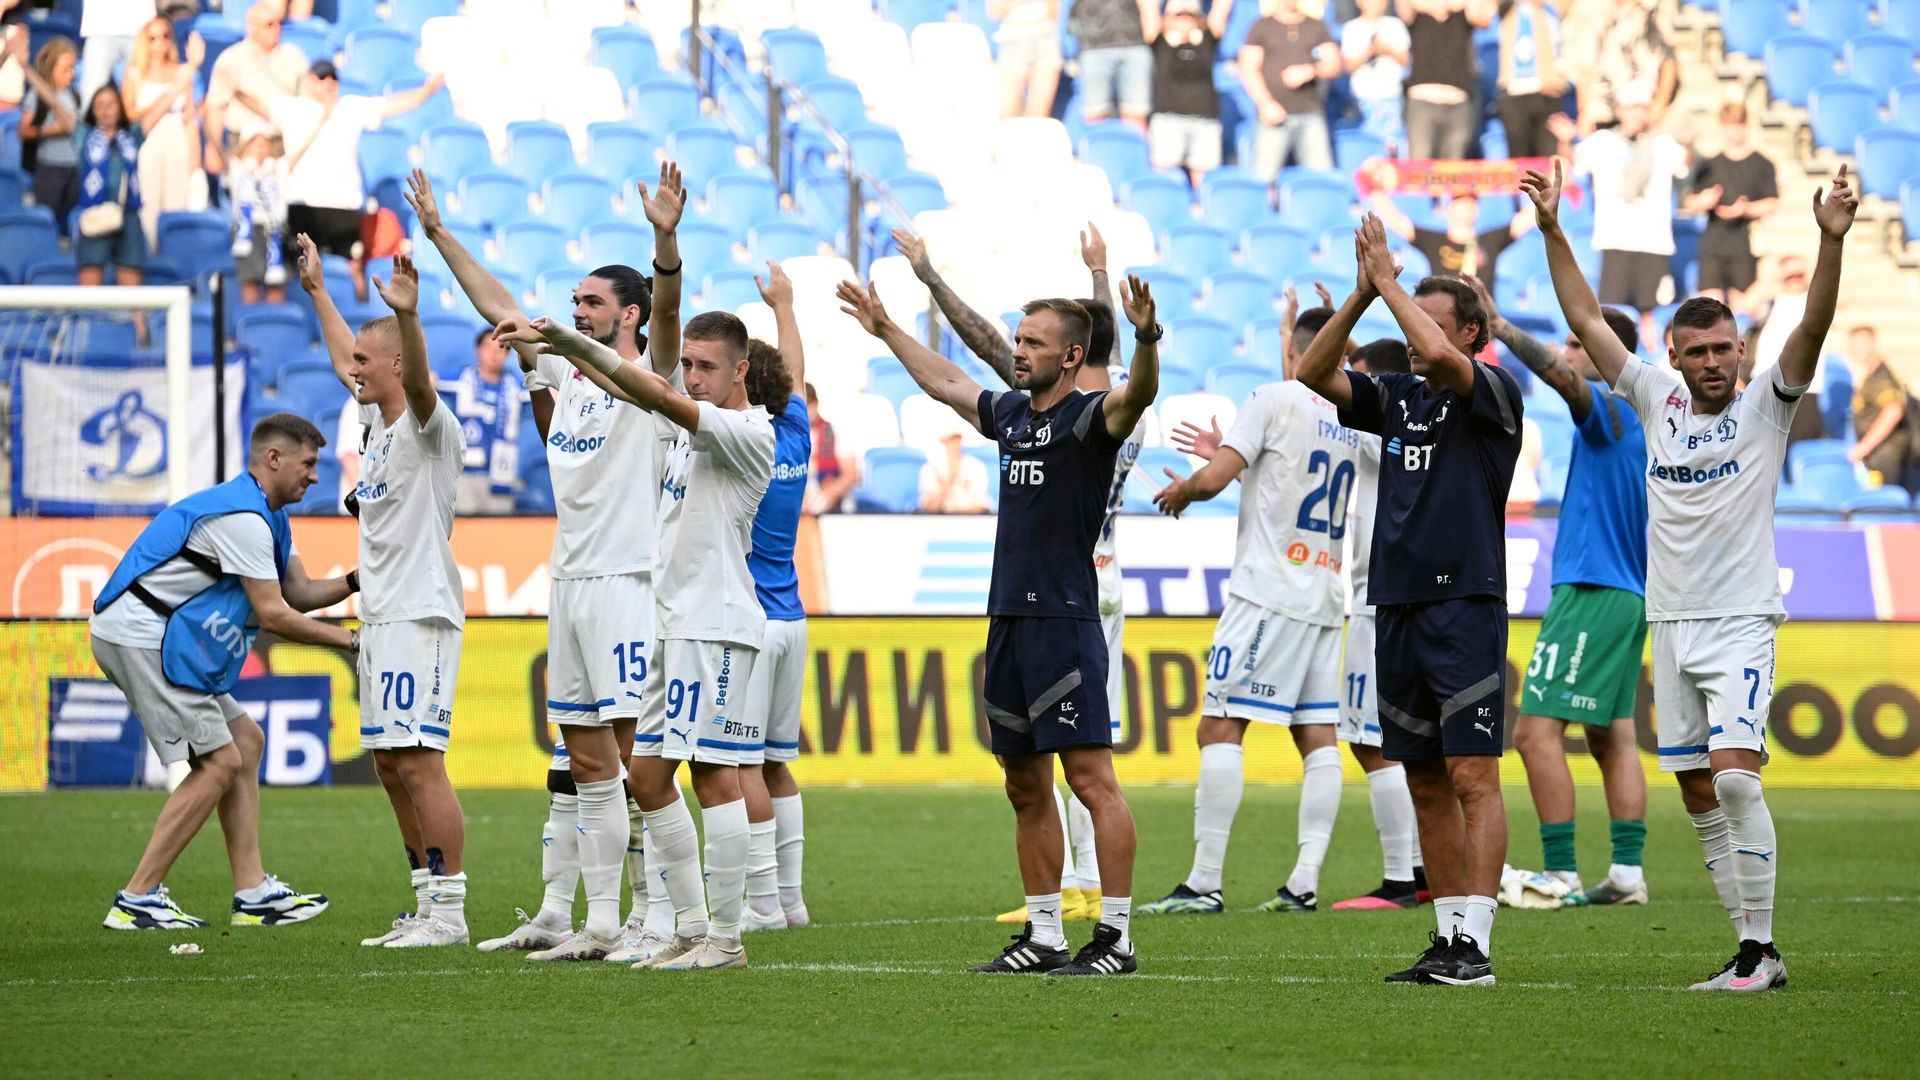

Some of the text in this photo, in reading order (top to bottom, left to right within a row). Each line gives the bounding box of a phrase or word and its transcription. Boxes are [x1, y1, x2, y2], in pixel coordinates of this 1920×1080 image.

[1009, 460, 1045, 485] ВТБ
[1649, 457, 1740, 483] BetBoom
[1296, 449, 1355, 540] 20
[612, 641, 648, 683] 15
[1244, 619, 1267, 671] BetBoom
[1527, 640, 1560, 681] 31
[381, 671, 415, 711] 70
[715, 647, 731, 706] BetBoom
[1250, 682, 1277, 697] ВТБ
[1347, 672, 1367, 710] 11
[1743, 667, 1760, 710] 7
[665, 678, 702, 722] 91
[1571, 694, 1598, 711] ВТБ
